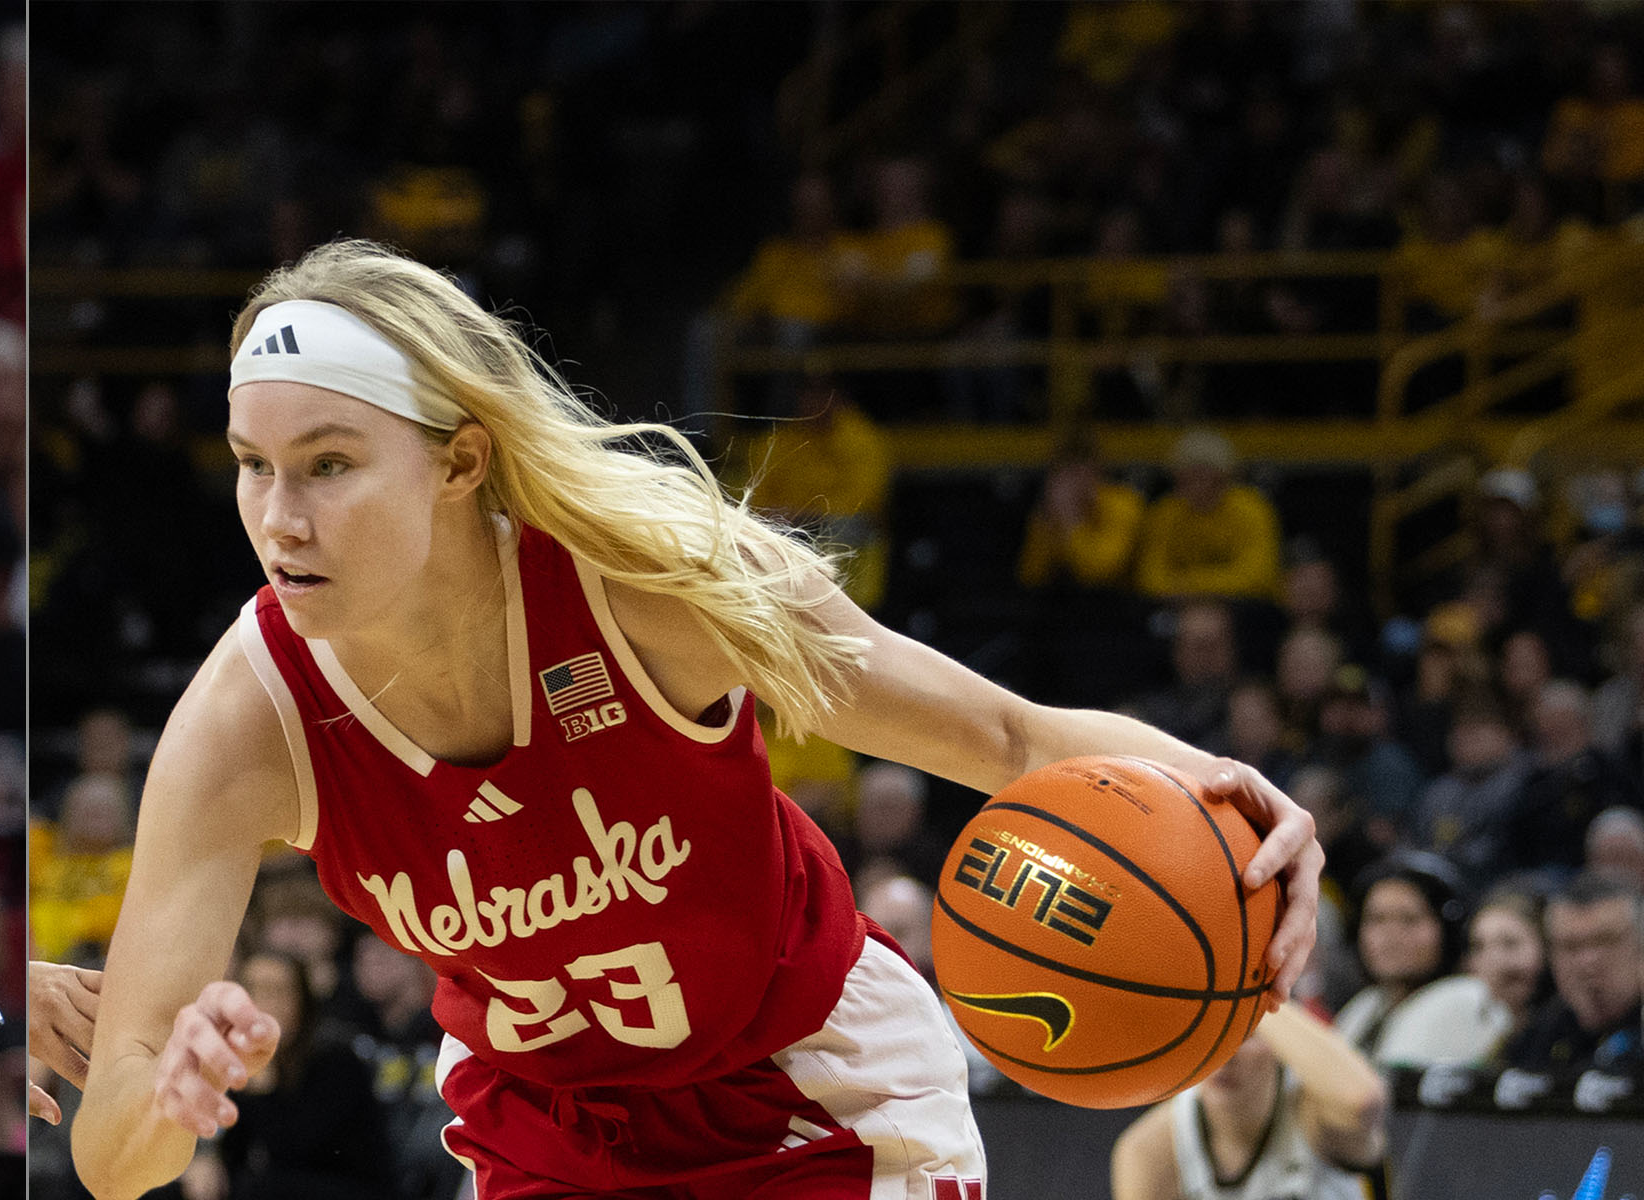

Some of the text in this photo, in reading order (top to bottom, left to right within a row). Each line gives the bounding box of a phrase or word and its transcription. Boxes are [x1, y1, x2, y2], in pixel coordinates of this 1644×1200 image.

[357, 787, 691, 957] Nebraska
[953, 836, 1114, 948] ELITE
[475, 941, 692, 1053] 23
